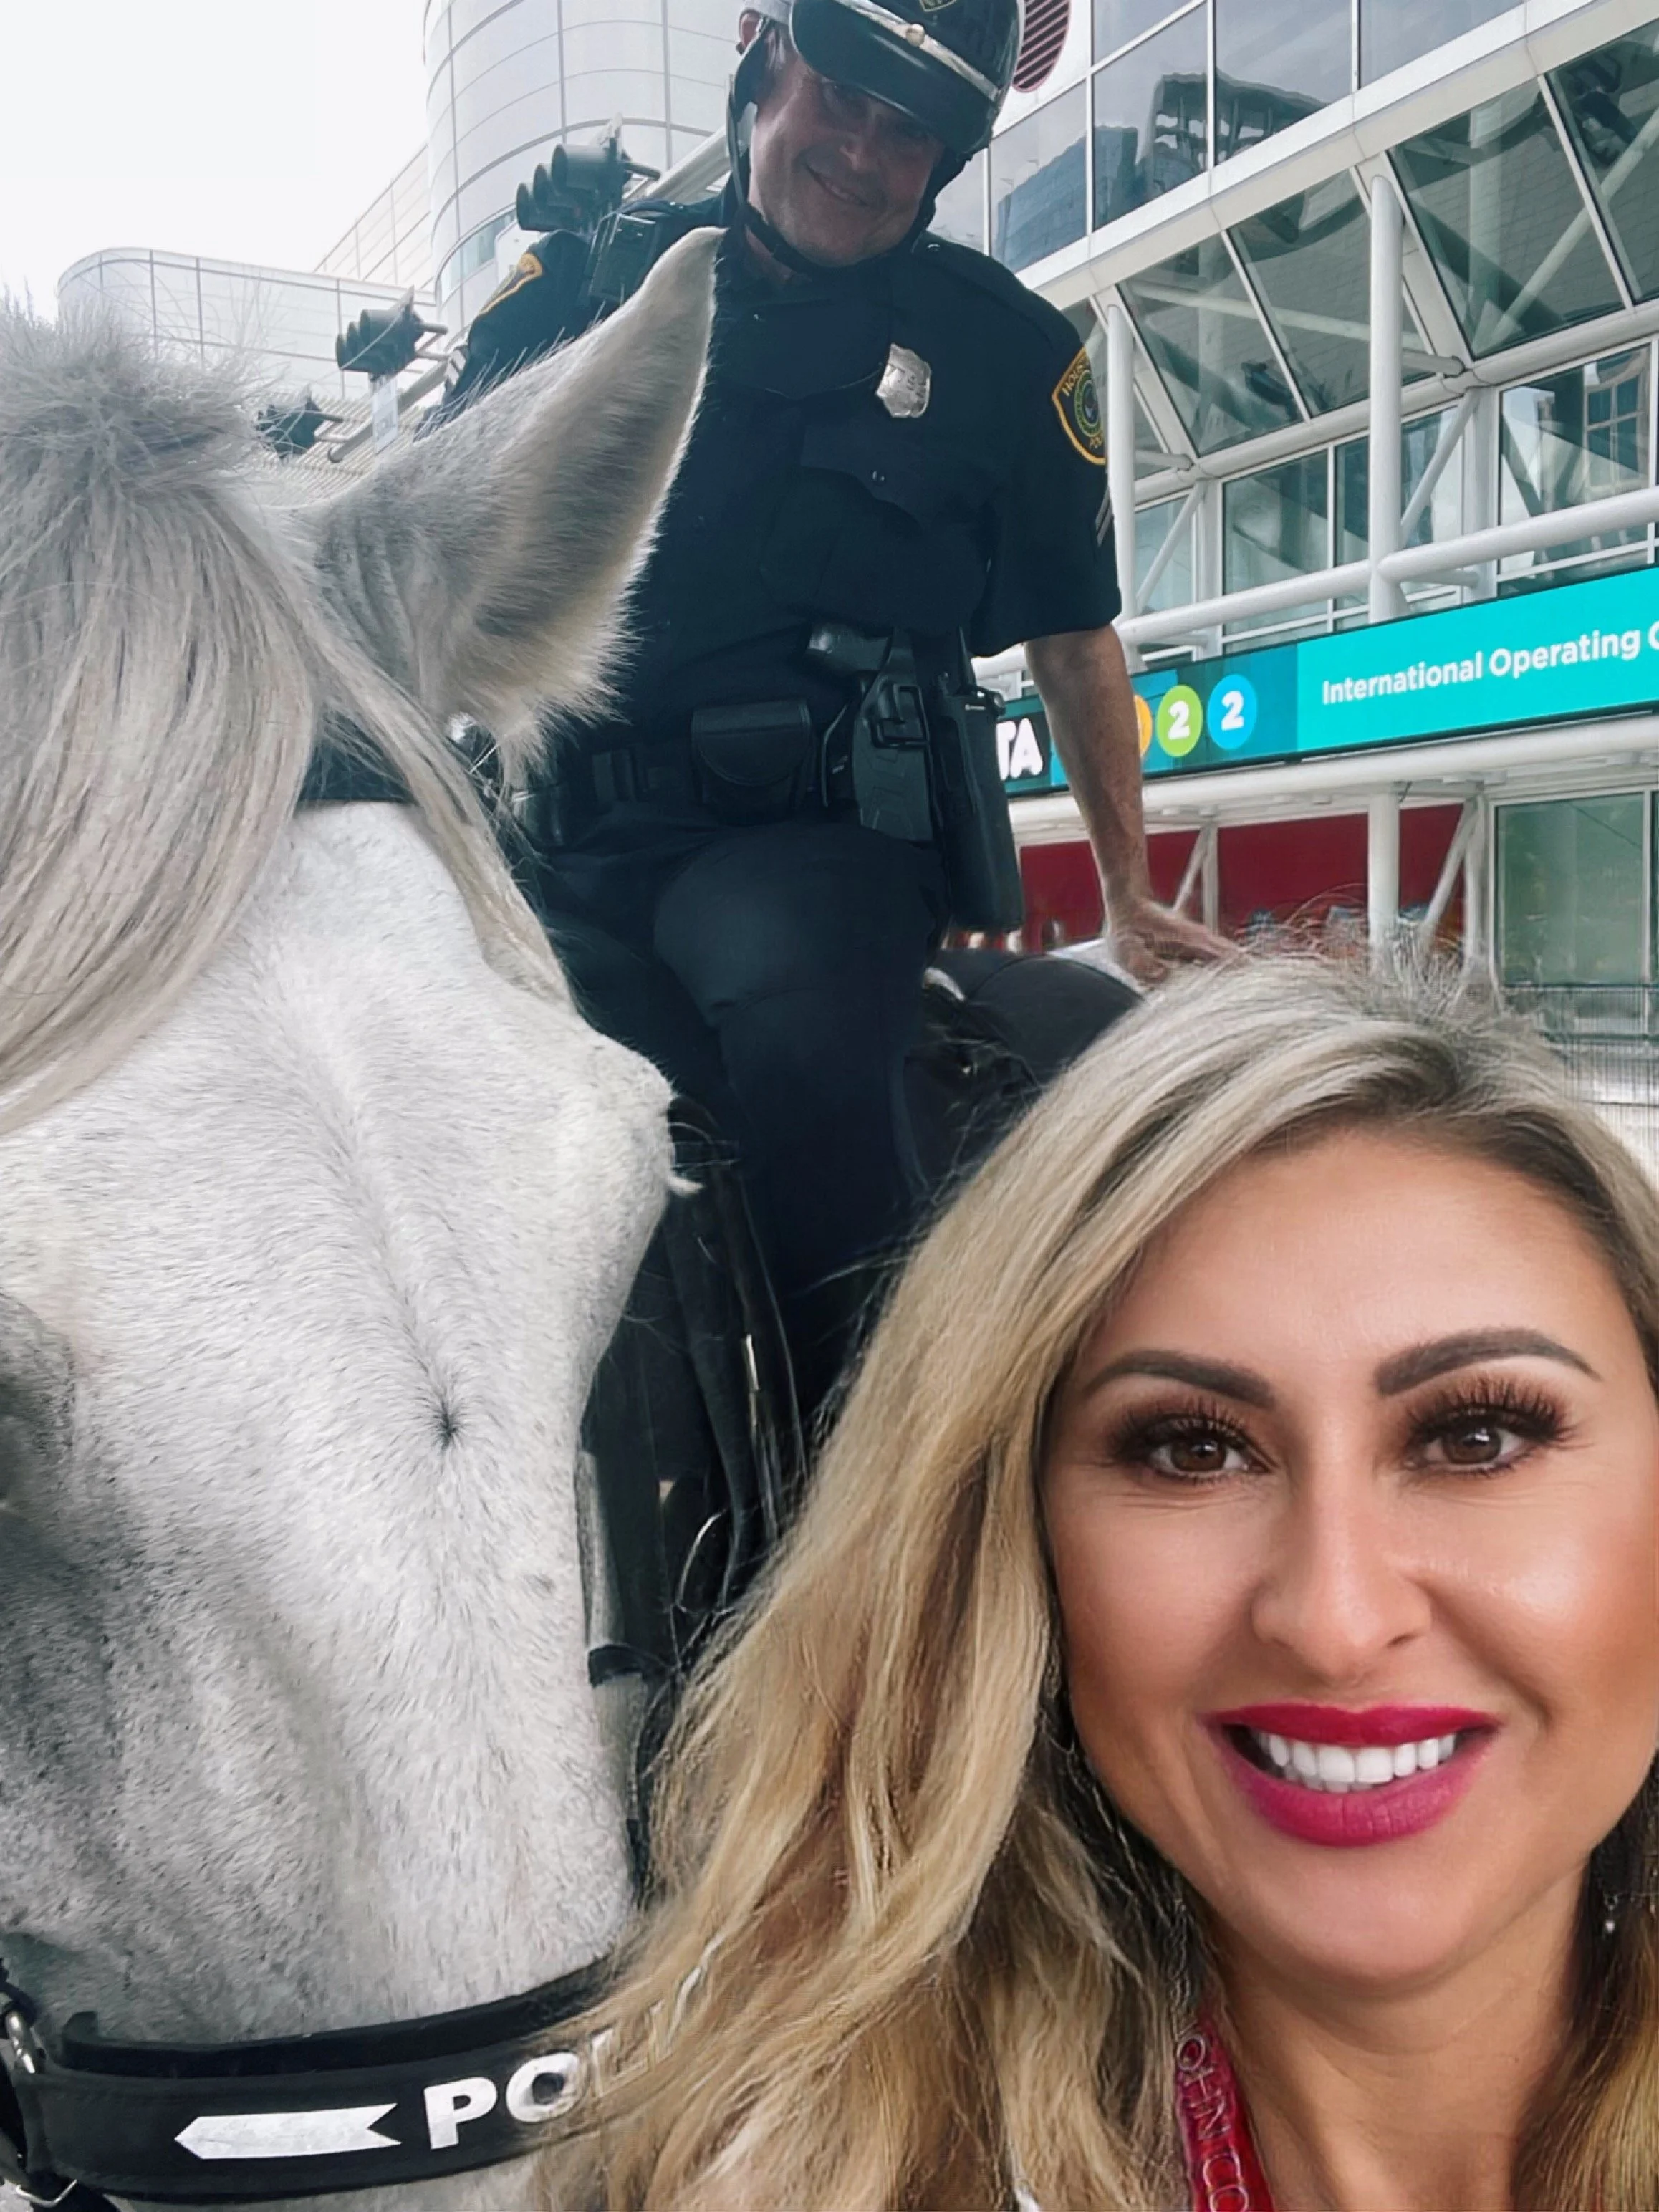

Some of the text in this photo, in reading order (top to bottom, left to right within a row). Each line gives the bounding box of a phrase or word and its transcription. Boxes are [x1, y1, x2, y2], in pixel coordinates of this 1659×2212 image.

[1322, 651, 1482, 705] International
[1489, 629, 1640, 678] Operating
[1168, 690, 1244, 741] 2 2
